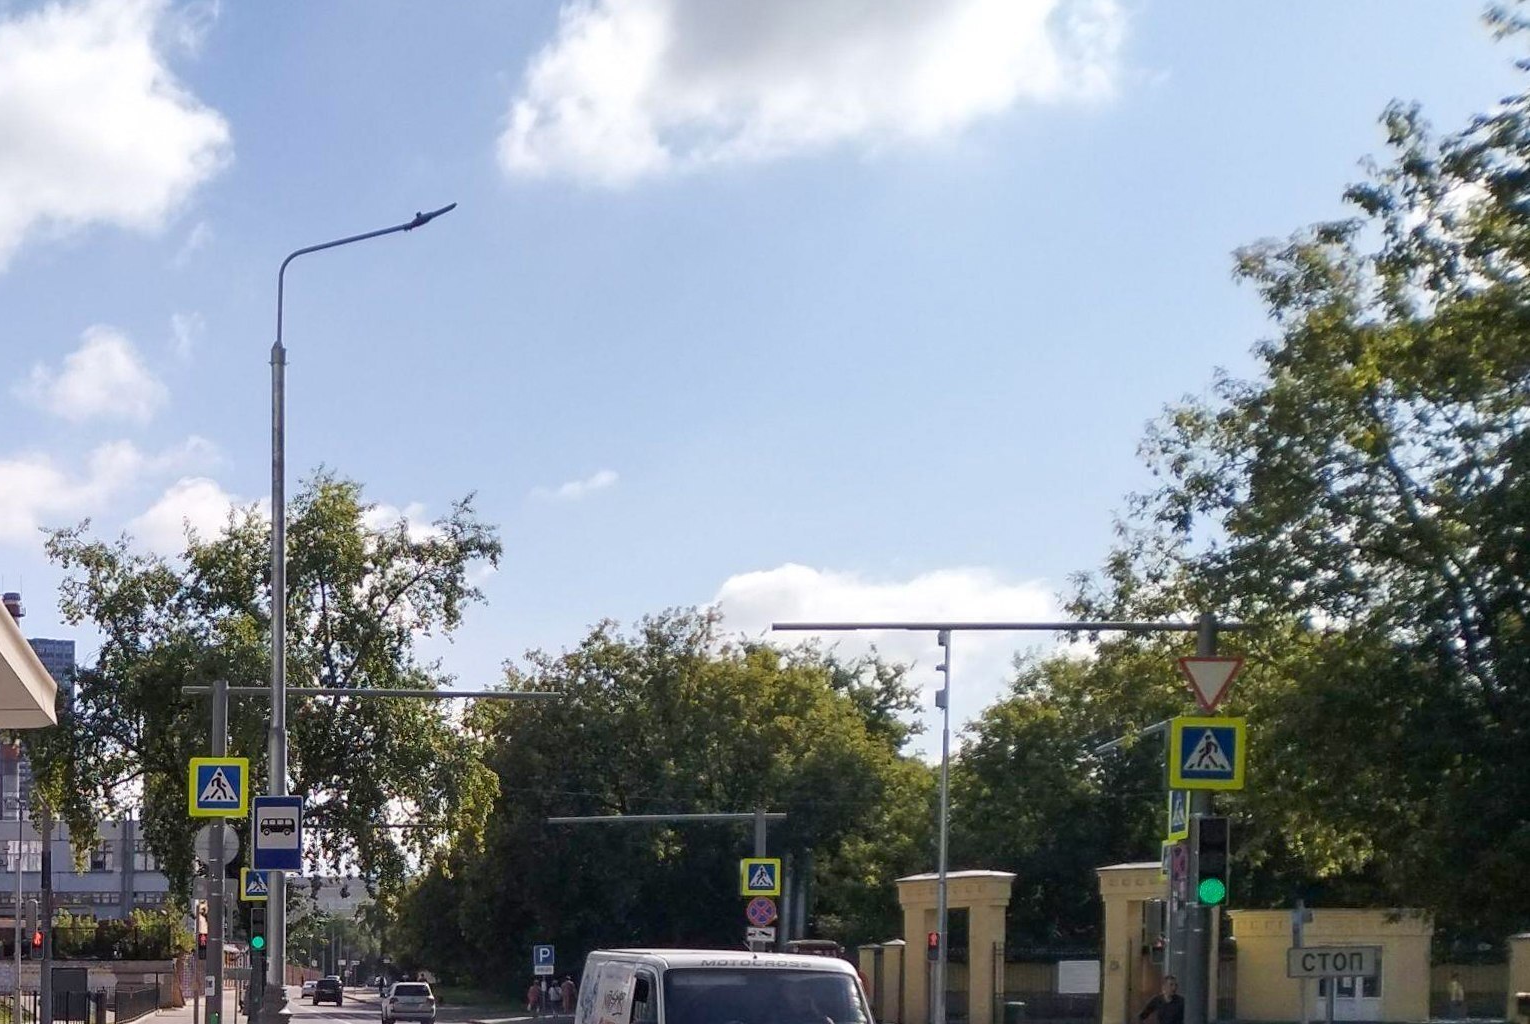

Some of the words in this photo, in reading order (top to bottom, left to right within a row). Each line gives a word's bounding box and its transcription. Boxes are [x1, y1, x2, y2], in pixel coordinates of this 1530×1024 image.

[539, 948, 550, 963] P
[1302, 952, 1364, 972] СТОП
[700, 959, 812, 969] MOTOCROSS
